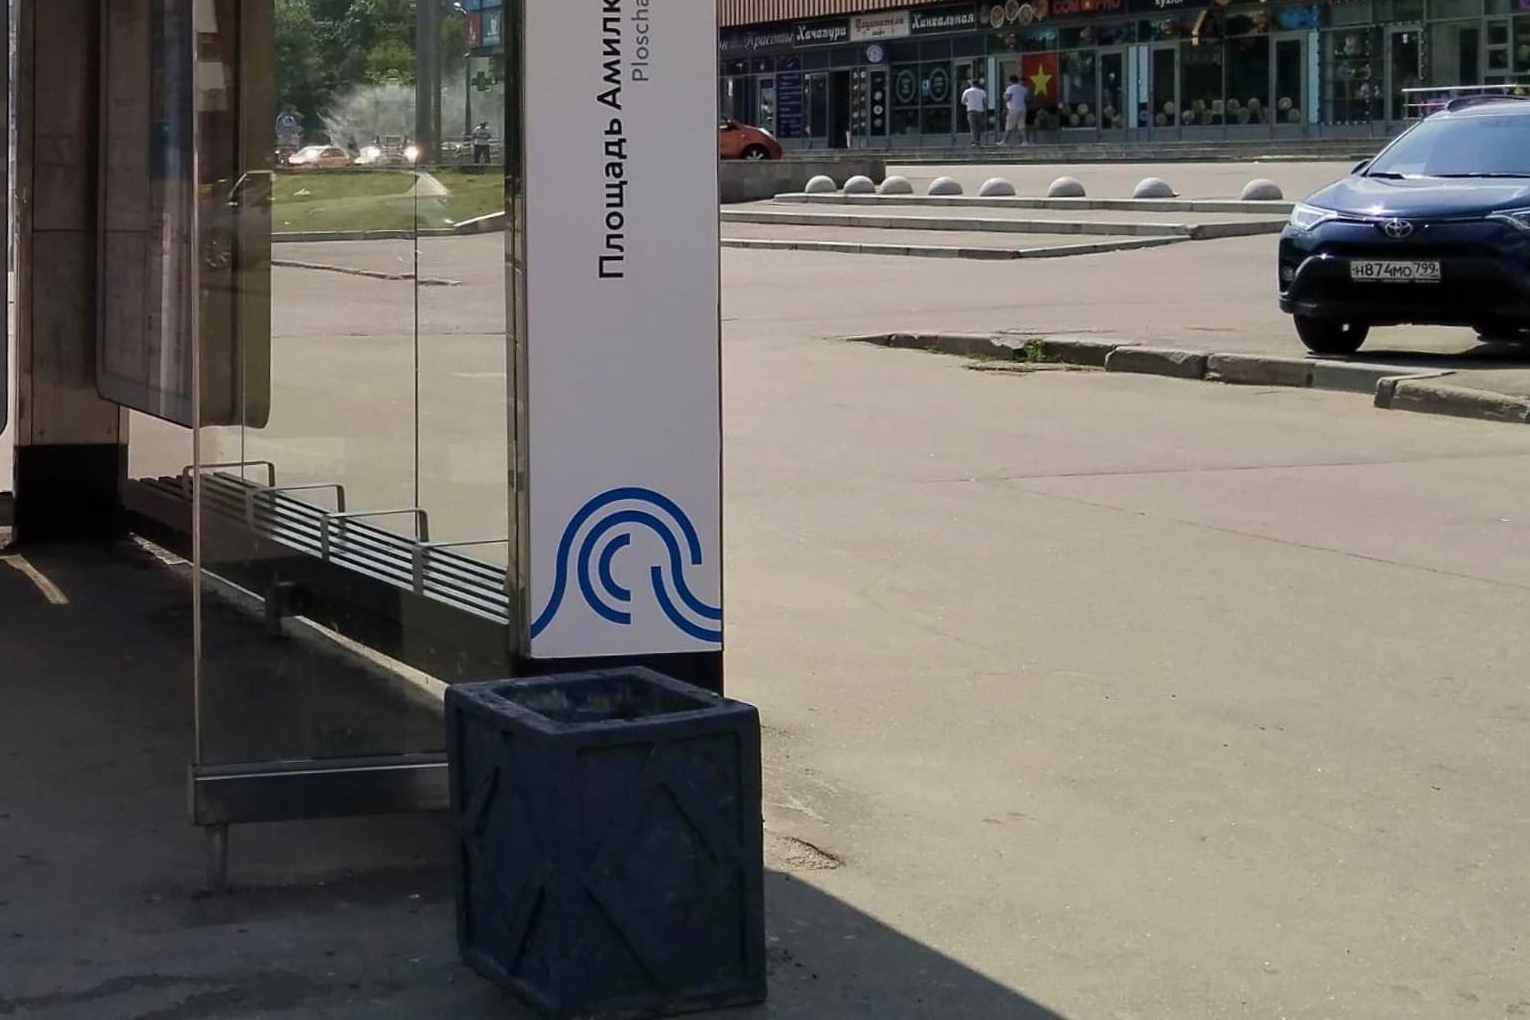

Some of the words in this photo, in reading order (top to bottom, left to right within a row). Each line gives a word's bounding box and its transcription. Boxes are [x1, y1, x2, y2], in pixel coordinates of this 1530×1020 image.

[911, 10, 975, 30] Хинкальная
[796, 25, 846, 41] Хачапури
[599, 118, 627, 279] Площадь
